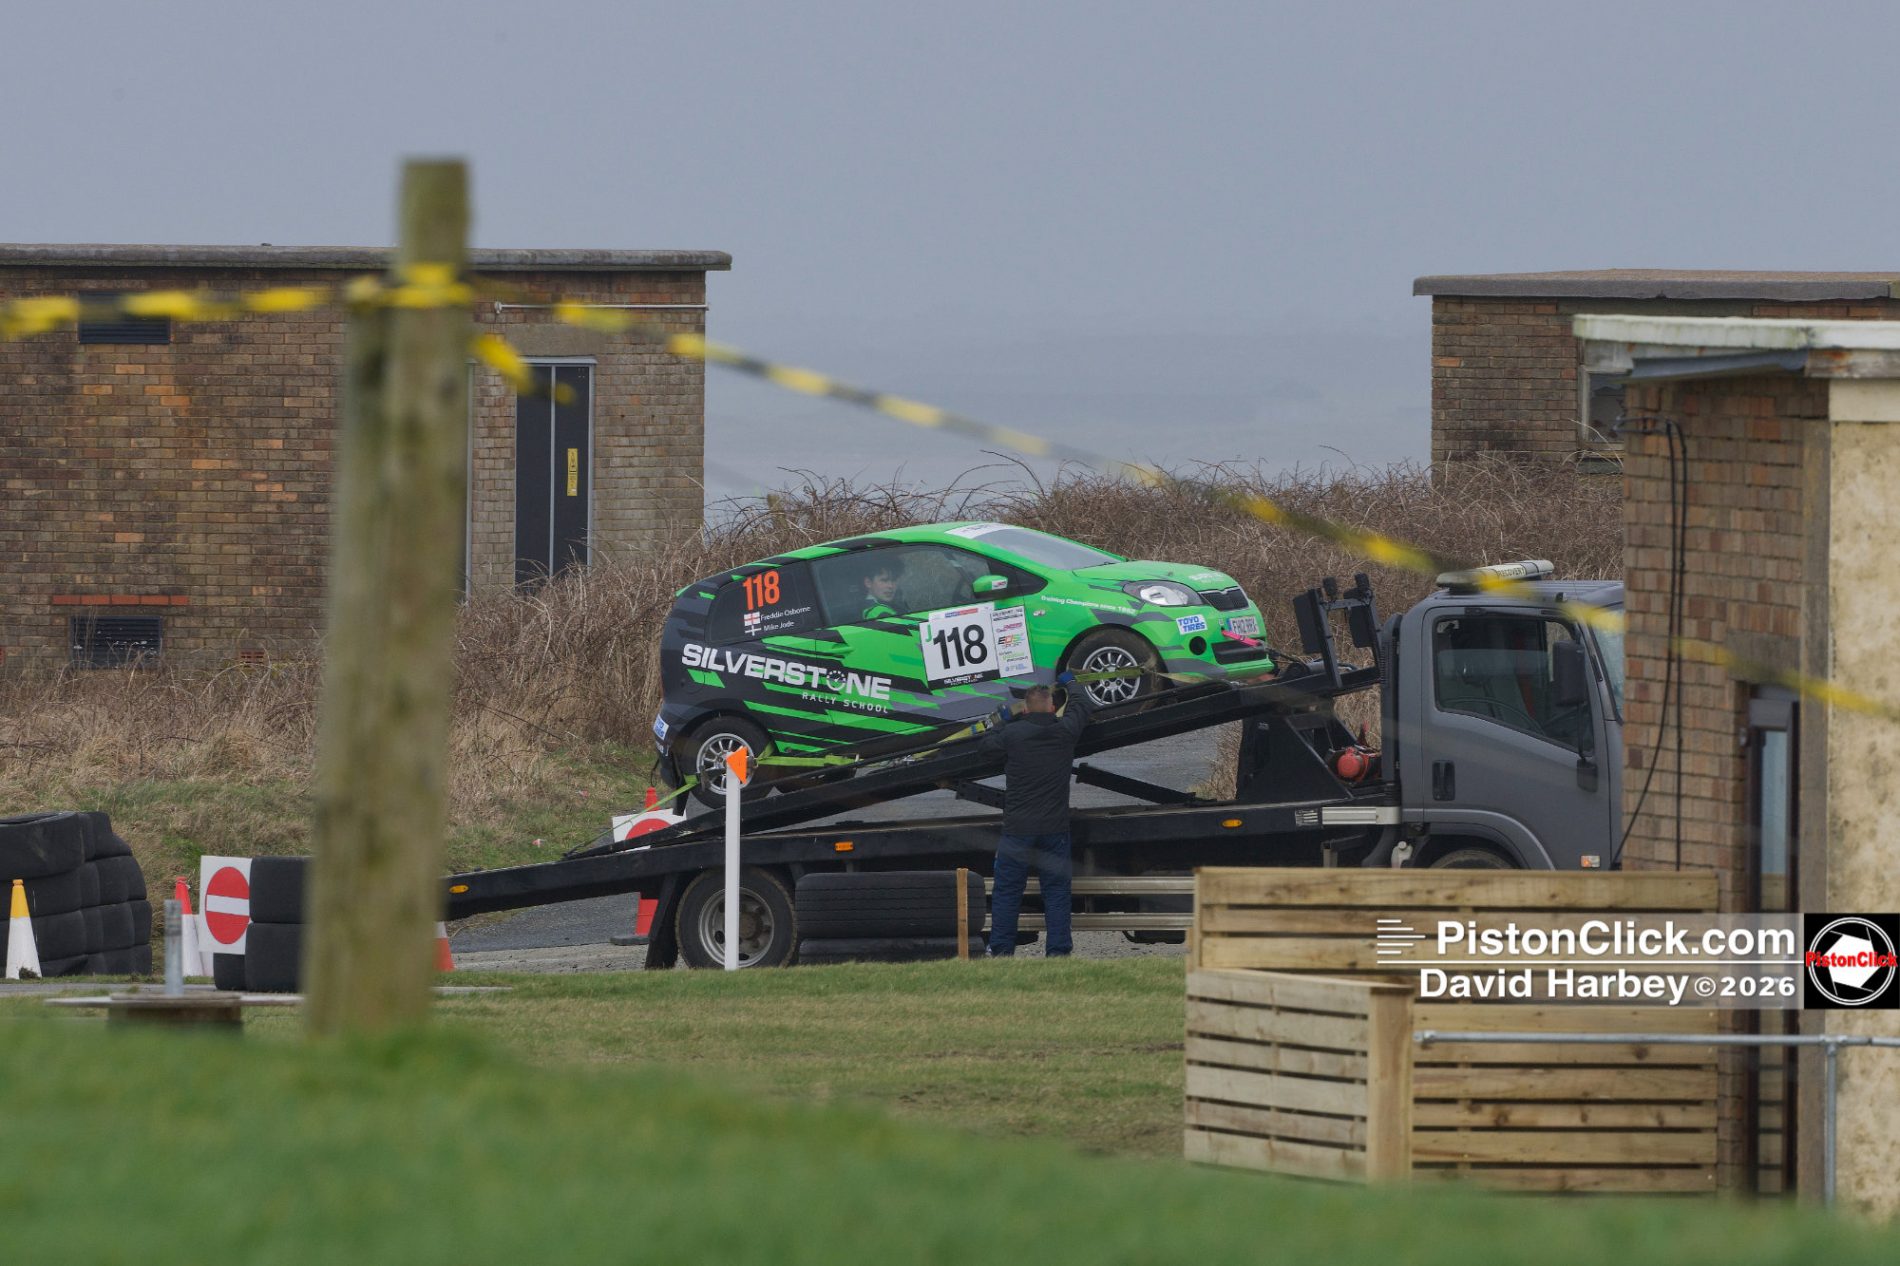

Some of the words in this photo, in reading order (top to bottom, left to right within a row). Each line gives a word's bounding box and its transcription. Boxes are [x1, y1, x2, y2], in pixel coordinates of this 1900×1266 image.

[743, 570, 780, 610] 118
[760, 610, 783, 621] Freddie
[784, 606, 811, 617] Osborne
[1177, 616, 1199, 626] TOYO
[763, 623, 779, 632] Mike
[1183, 622, 1206, 632] TIRES
[933, 624, 987, 670] 118
[682, 643, 891, 700] SILVERSTONE
[802, 691, 836, 705] RALLY
[843, 699, 889, 714] SCHOOL
